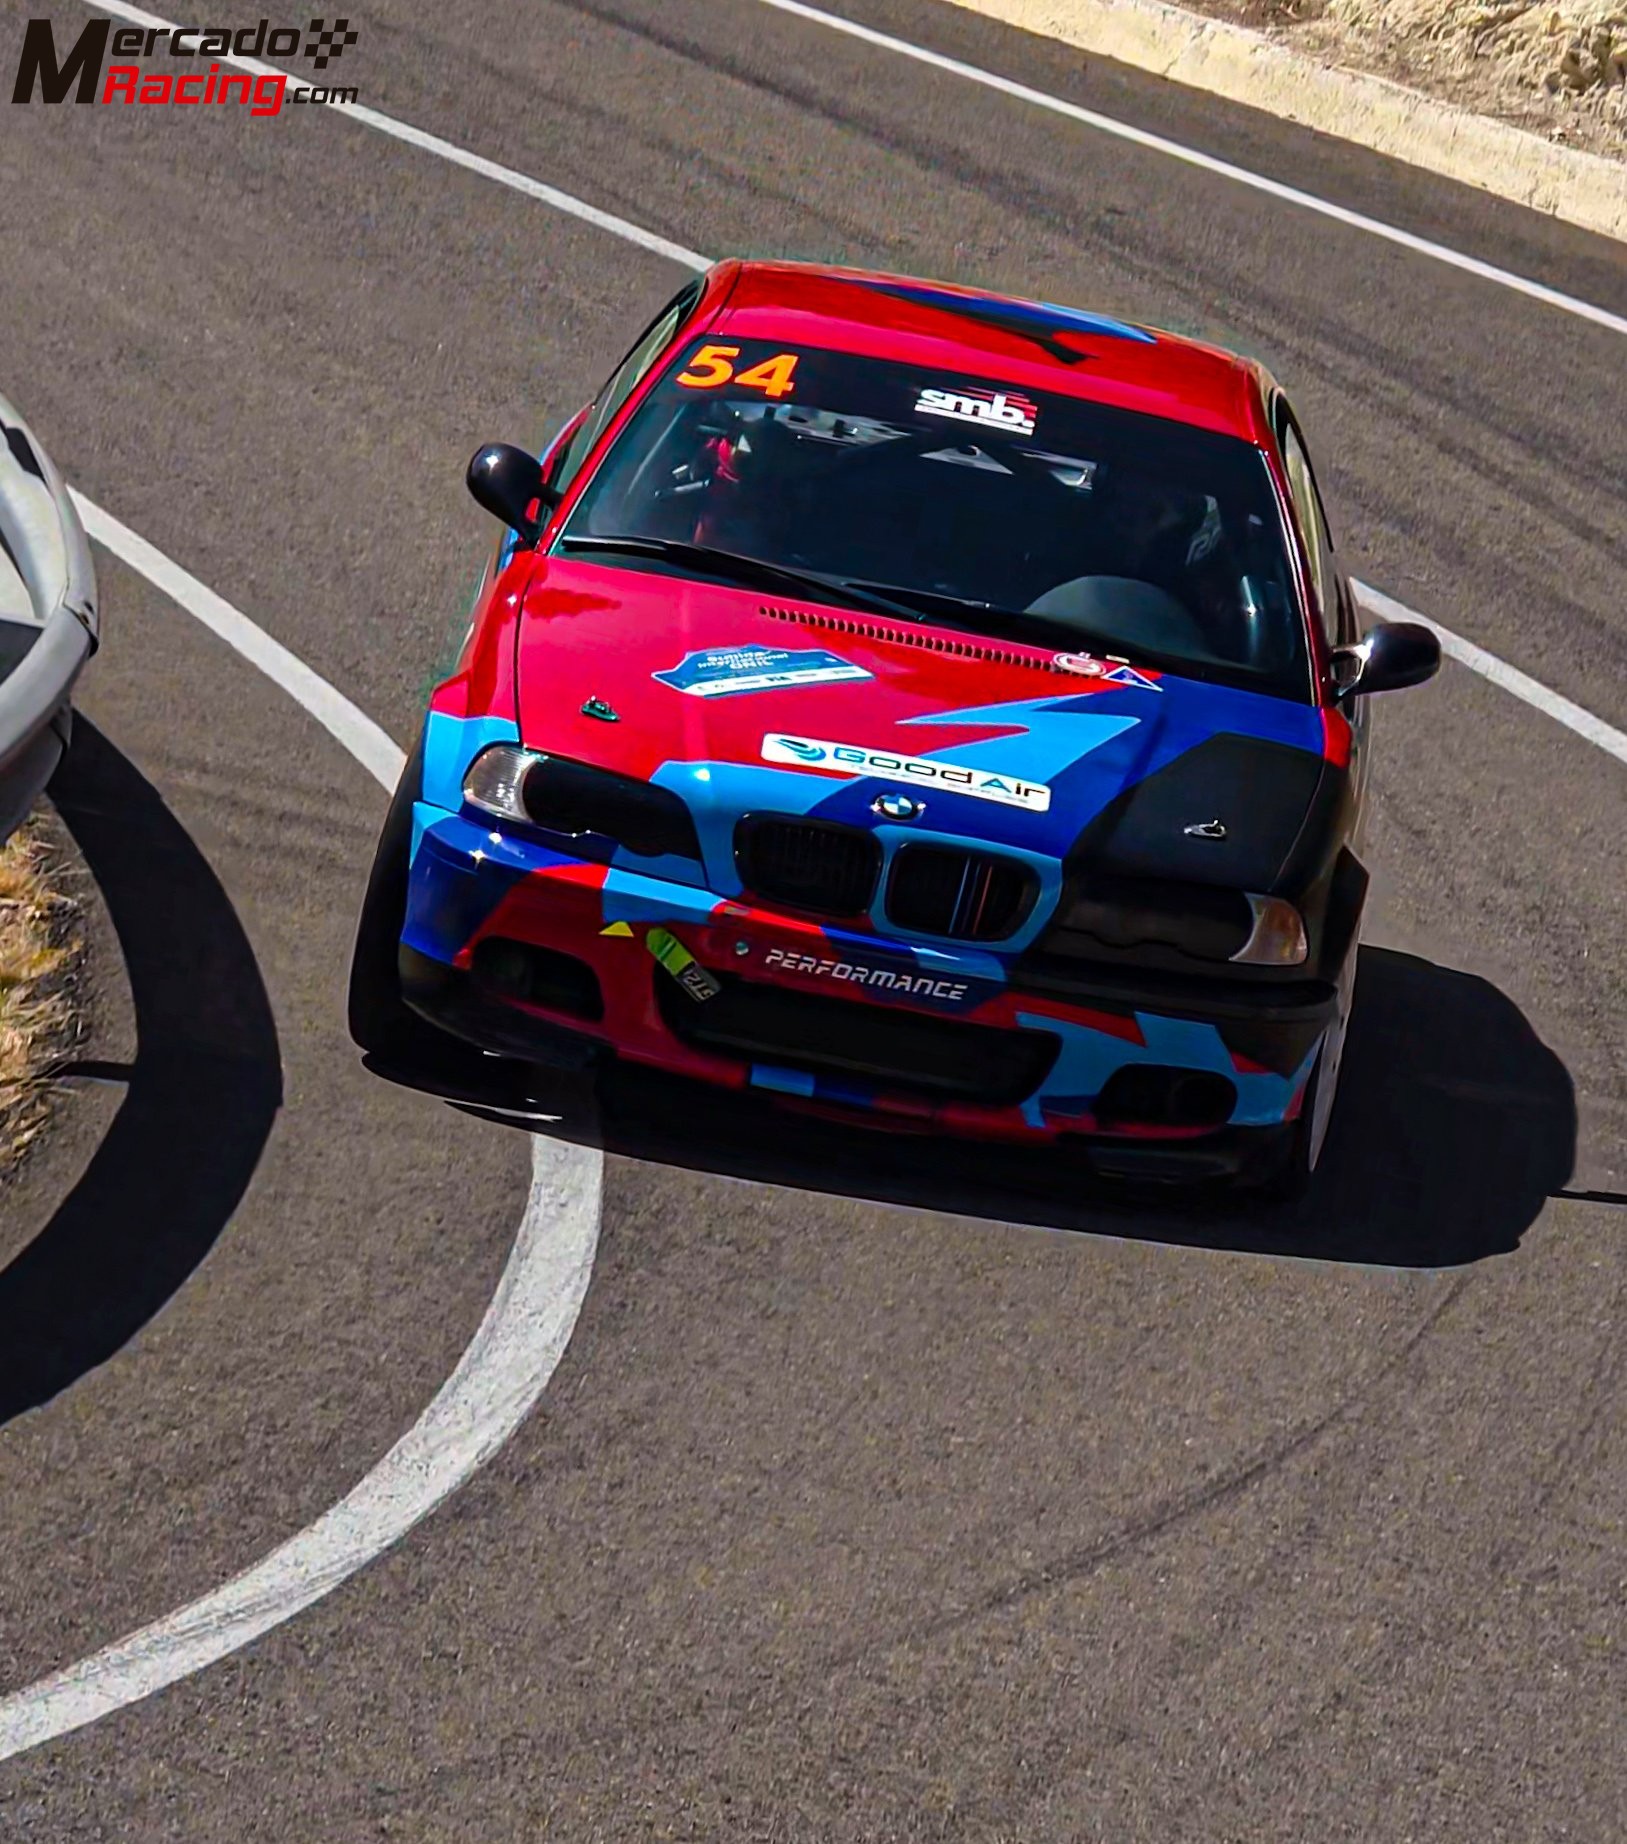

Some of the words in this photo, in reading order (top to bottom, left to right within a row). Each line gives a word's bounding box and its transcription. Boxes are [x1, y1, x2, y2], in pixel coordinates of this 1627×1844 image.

[675, 344, 799, 397] 54
[833, 746, 972, 784] Good
[980, 777, 1046, 798] Air
[765, 949, 969, 1000] PERFORMANCE
